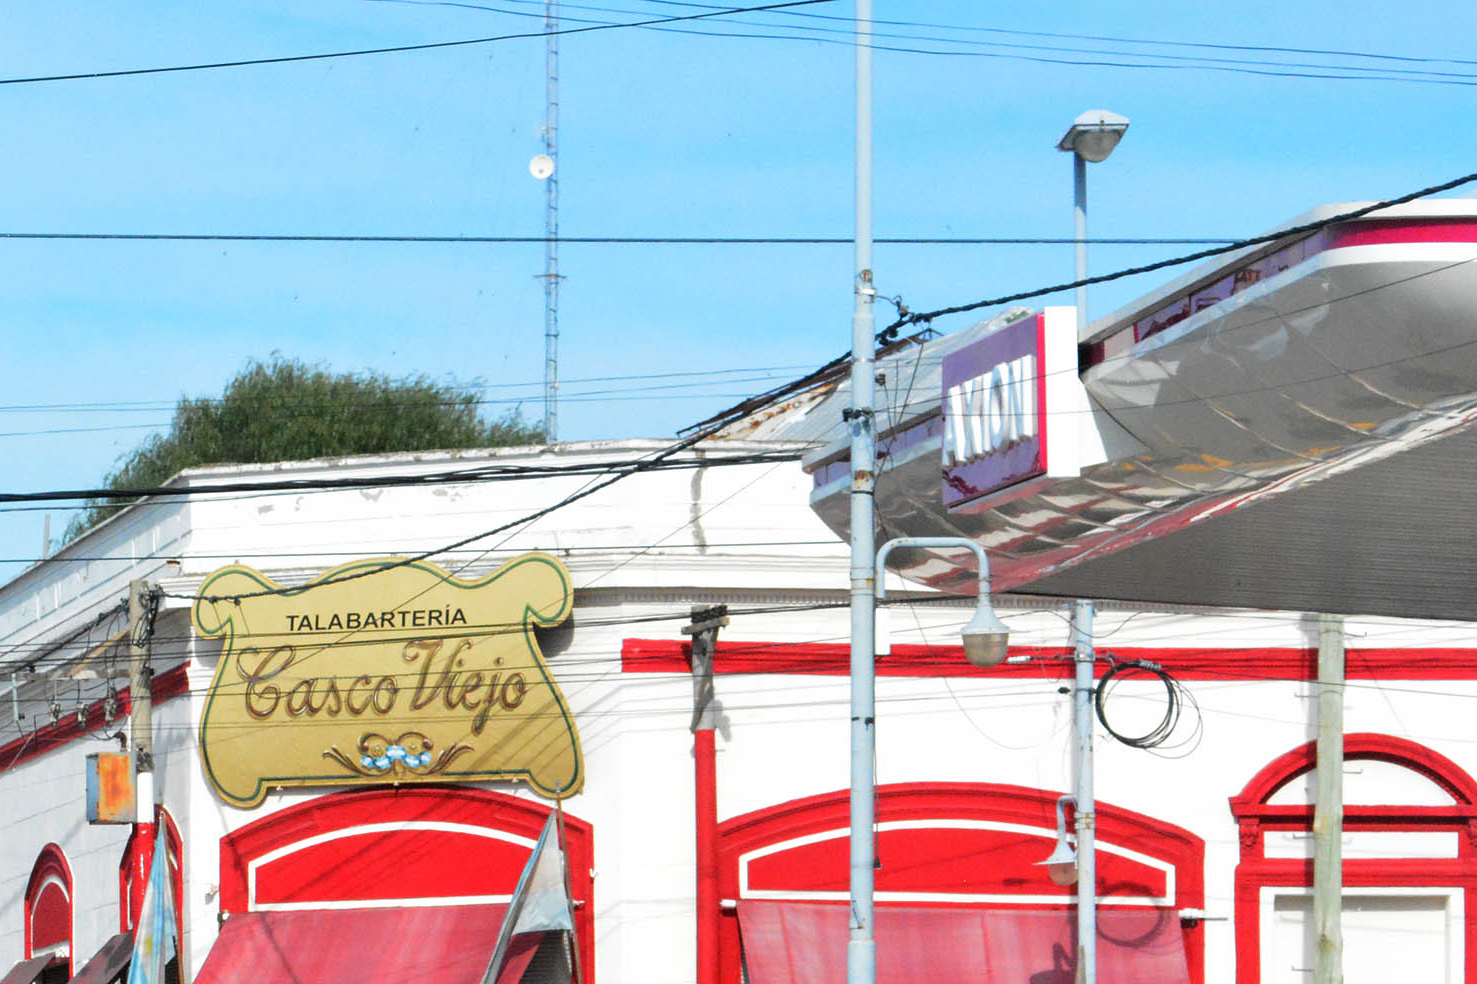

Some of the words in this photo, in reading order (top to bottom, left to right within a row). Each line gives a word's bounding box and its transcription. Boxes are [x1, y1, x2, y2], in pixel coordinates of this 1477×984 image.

[286, 605, 467, 631] TALABARTERÍA
[237, 644, 400, 719] Casco
[403, 639, 528, 735] Viejo
